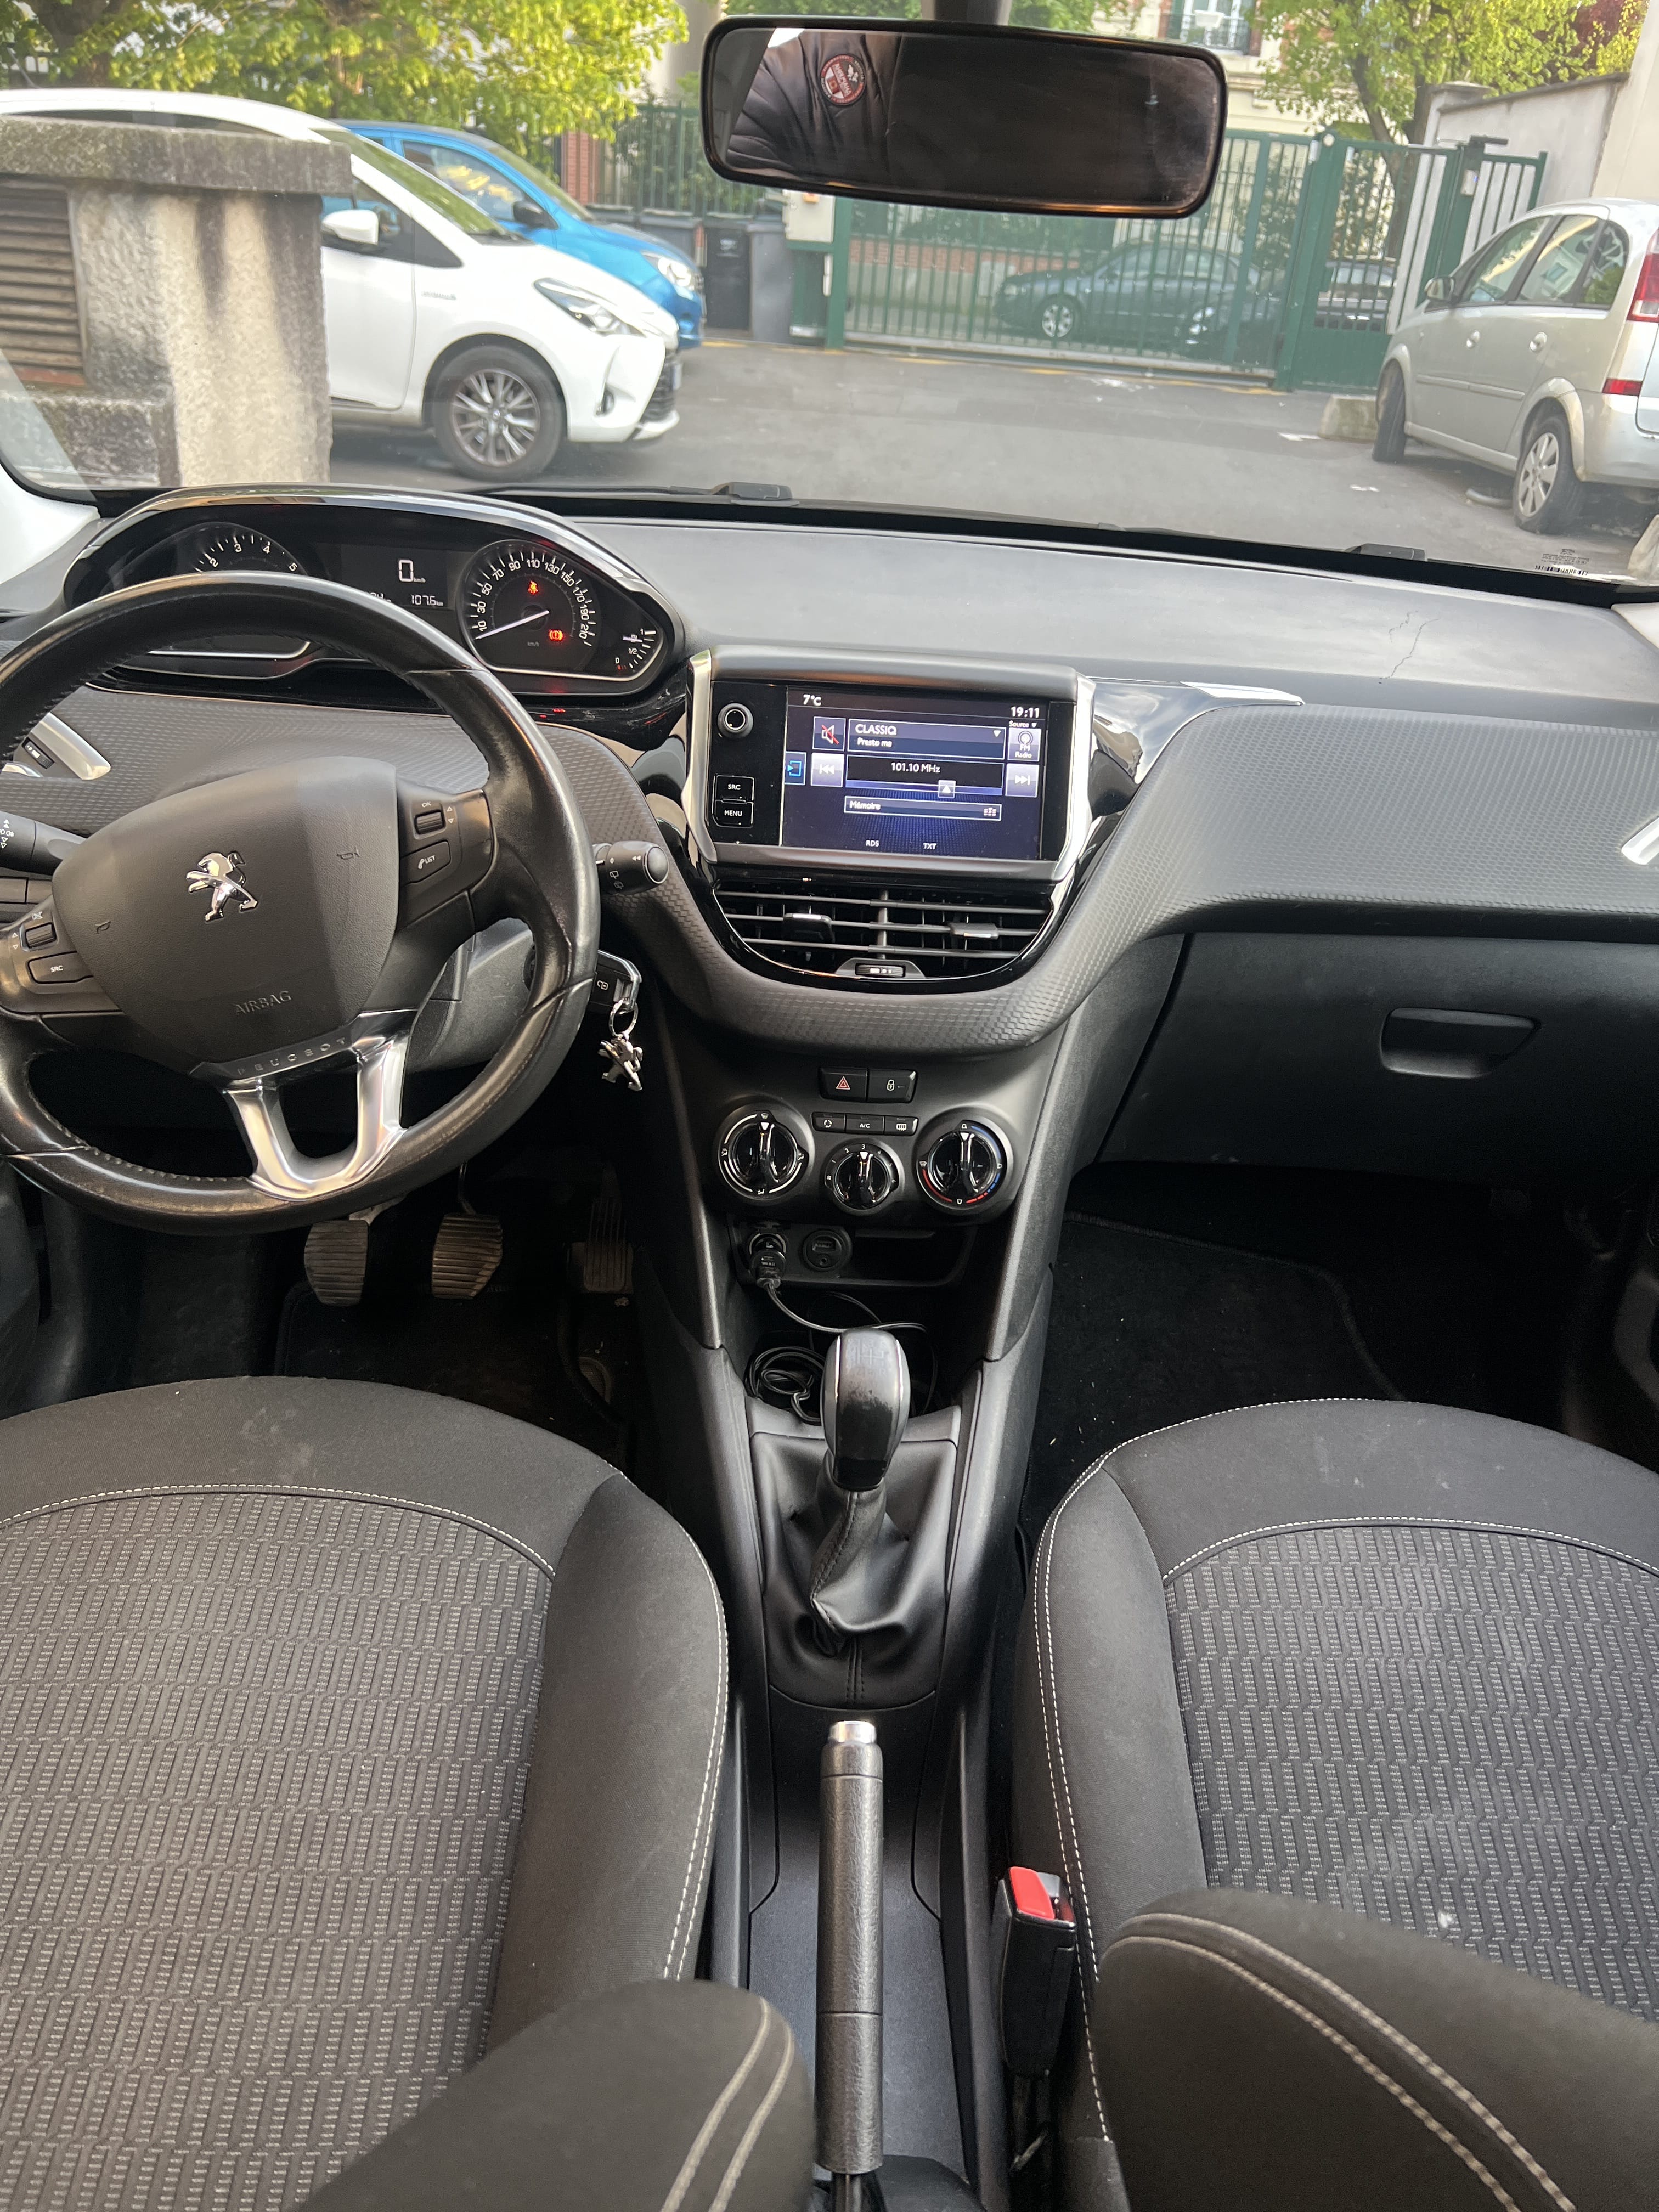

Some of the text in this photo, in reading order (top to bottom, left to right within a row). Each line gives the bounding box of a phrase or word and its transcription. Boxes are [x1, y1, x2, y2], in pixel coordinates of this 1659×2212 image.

[234, 543, 242, 552] 3
[263, 546, 270, 554] 4
[210, 558, 219, 567] 2
[289, 562, 298, 572] 5
[508, 561, 521, 571] 90
[526, 560, 540, 568] 110
[544, 562, 560, 575] 130
[398, 560, 414, 582] 0
[492, 569, 504, 580] 70
[561, 572, 574, 587] 150
[482, 583, 493, 595] 50
[573, 586, 585, 602] 170
[477, 601, 486, 613] 30
[580, 604, 589, 620] 190
[478, 620, 487, 631] 10
[579, 624, 589, 639] 210
[803, 694, 822, 706] 7°C
[1011, 706, 1040, 718] 19:11
[855, 724, 897, 736] CLASSIQ
[857, 737, 880, 747] Presto
[891, 762, 941, 774] 101.10 MHz
[850, 800, 881, 810] Mémoire
[425, 855, 436, 864] LIST
[236, 990, 291, 1015] AIRBAG
